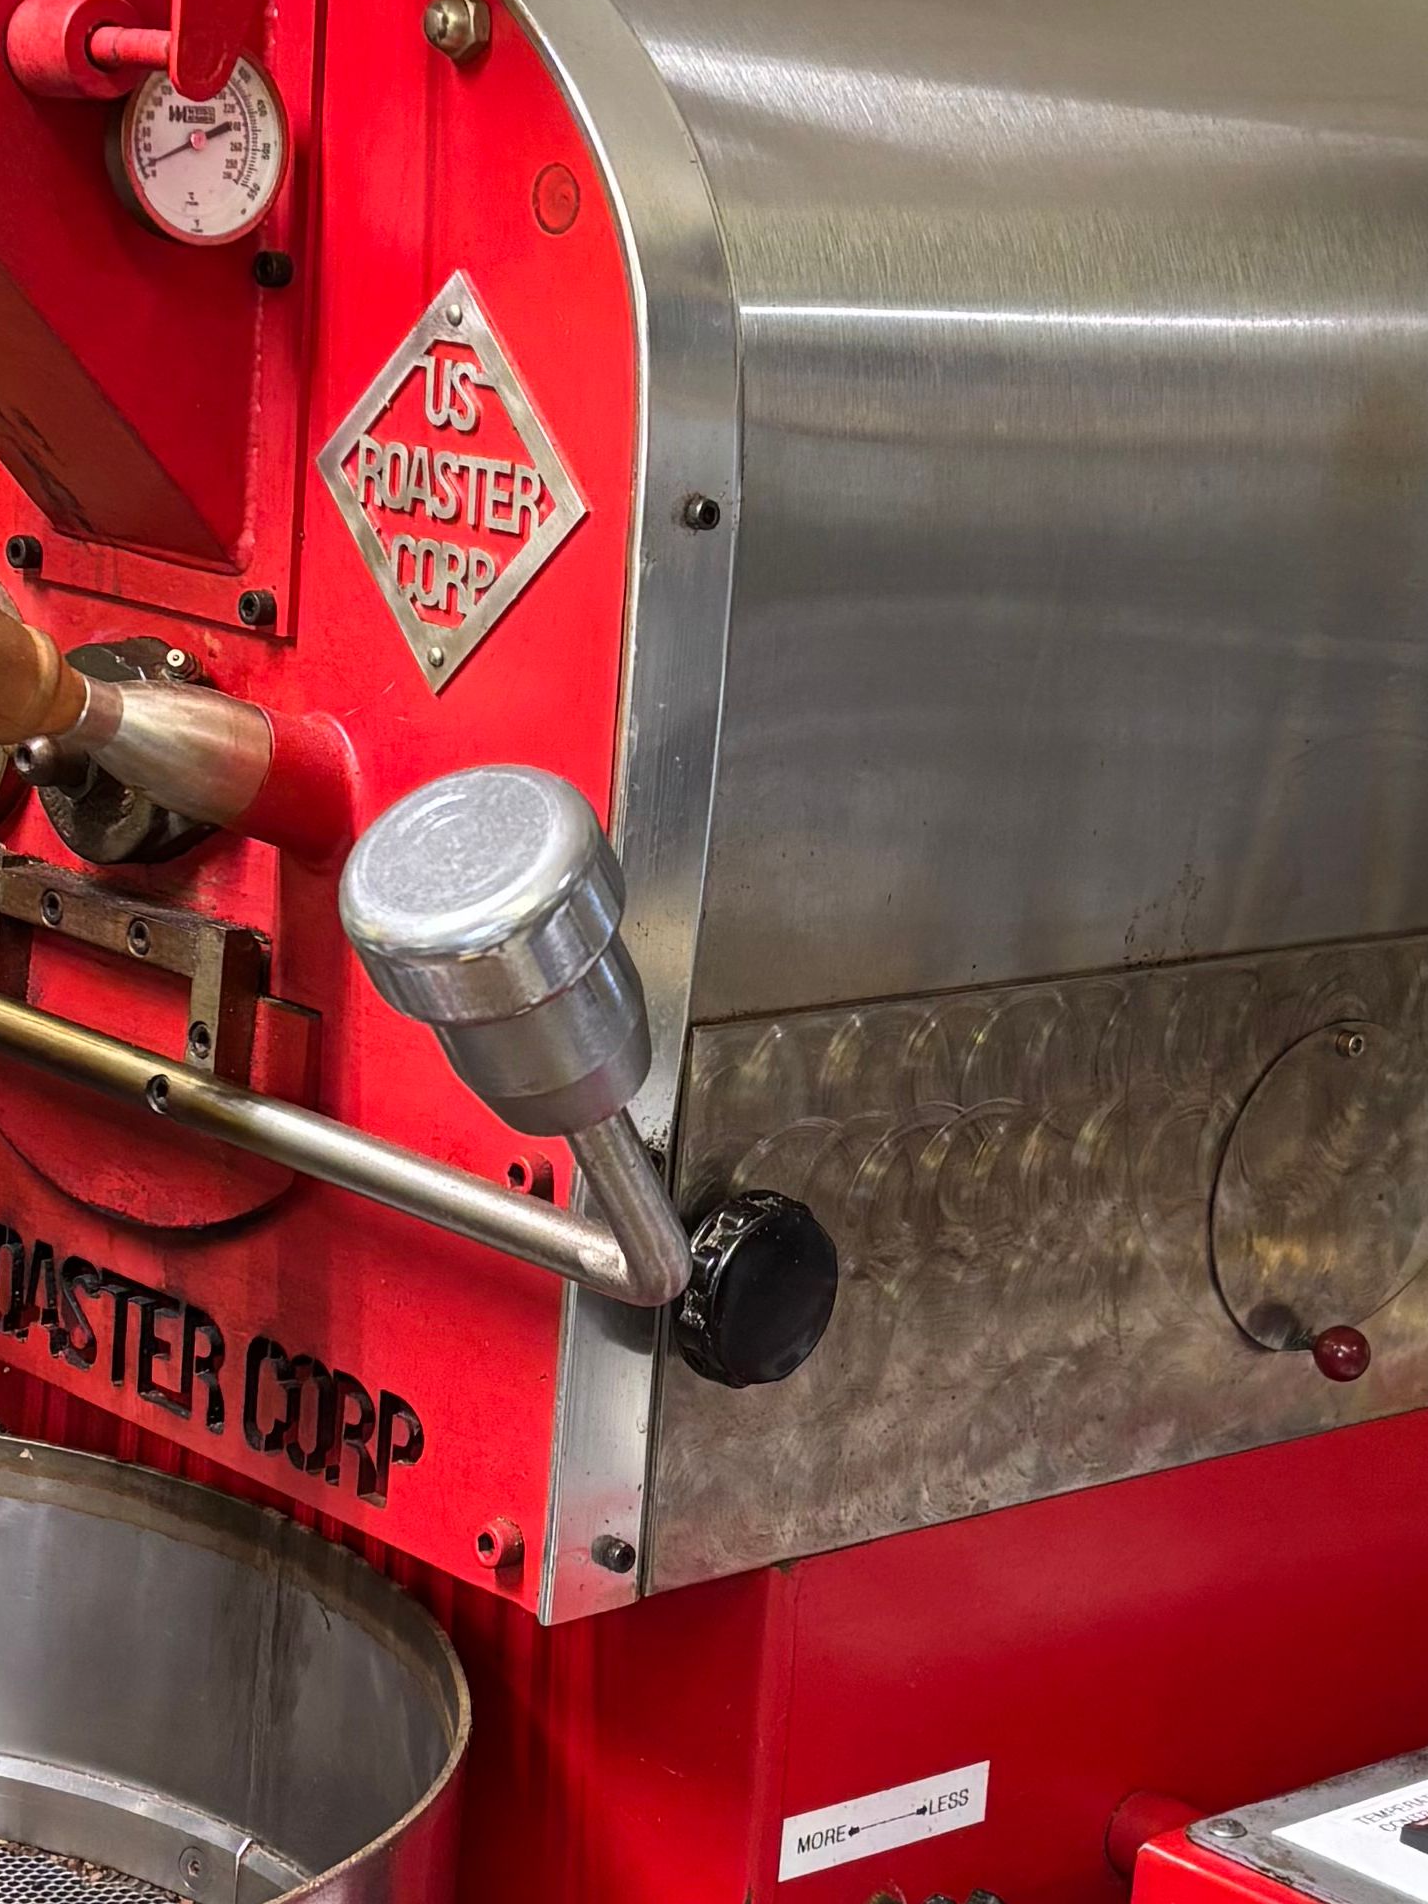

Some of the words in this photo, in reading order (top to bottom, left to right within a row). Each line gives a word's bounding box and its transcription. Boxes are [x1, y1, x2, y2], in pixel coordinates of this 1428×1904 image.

[423, 355, 484, 432] US
[356, 435, 543, 536] ROASTER
[389, 533, 496, 614] CORP
[243, 1335, 425, 1509] CORP
[797, 1824, 847, 1856] MORE
[928, 1789, 970, 1815] LESS
